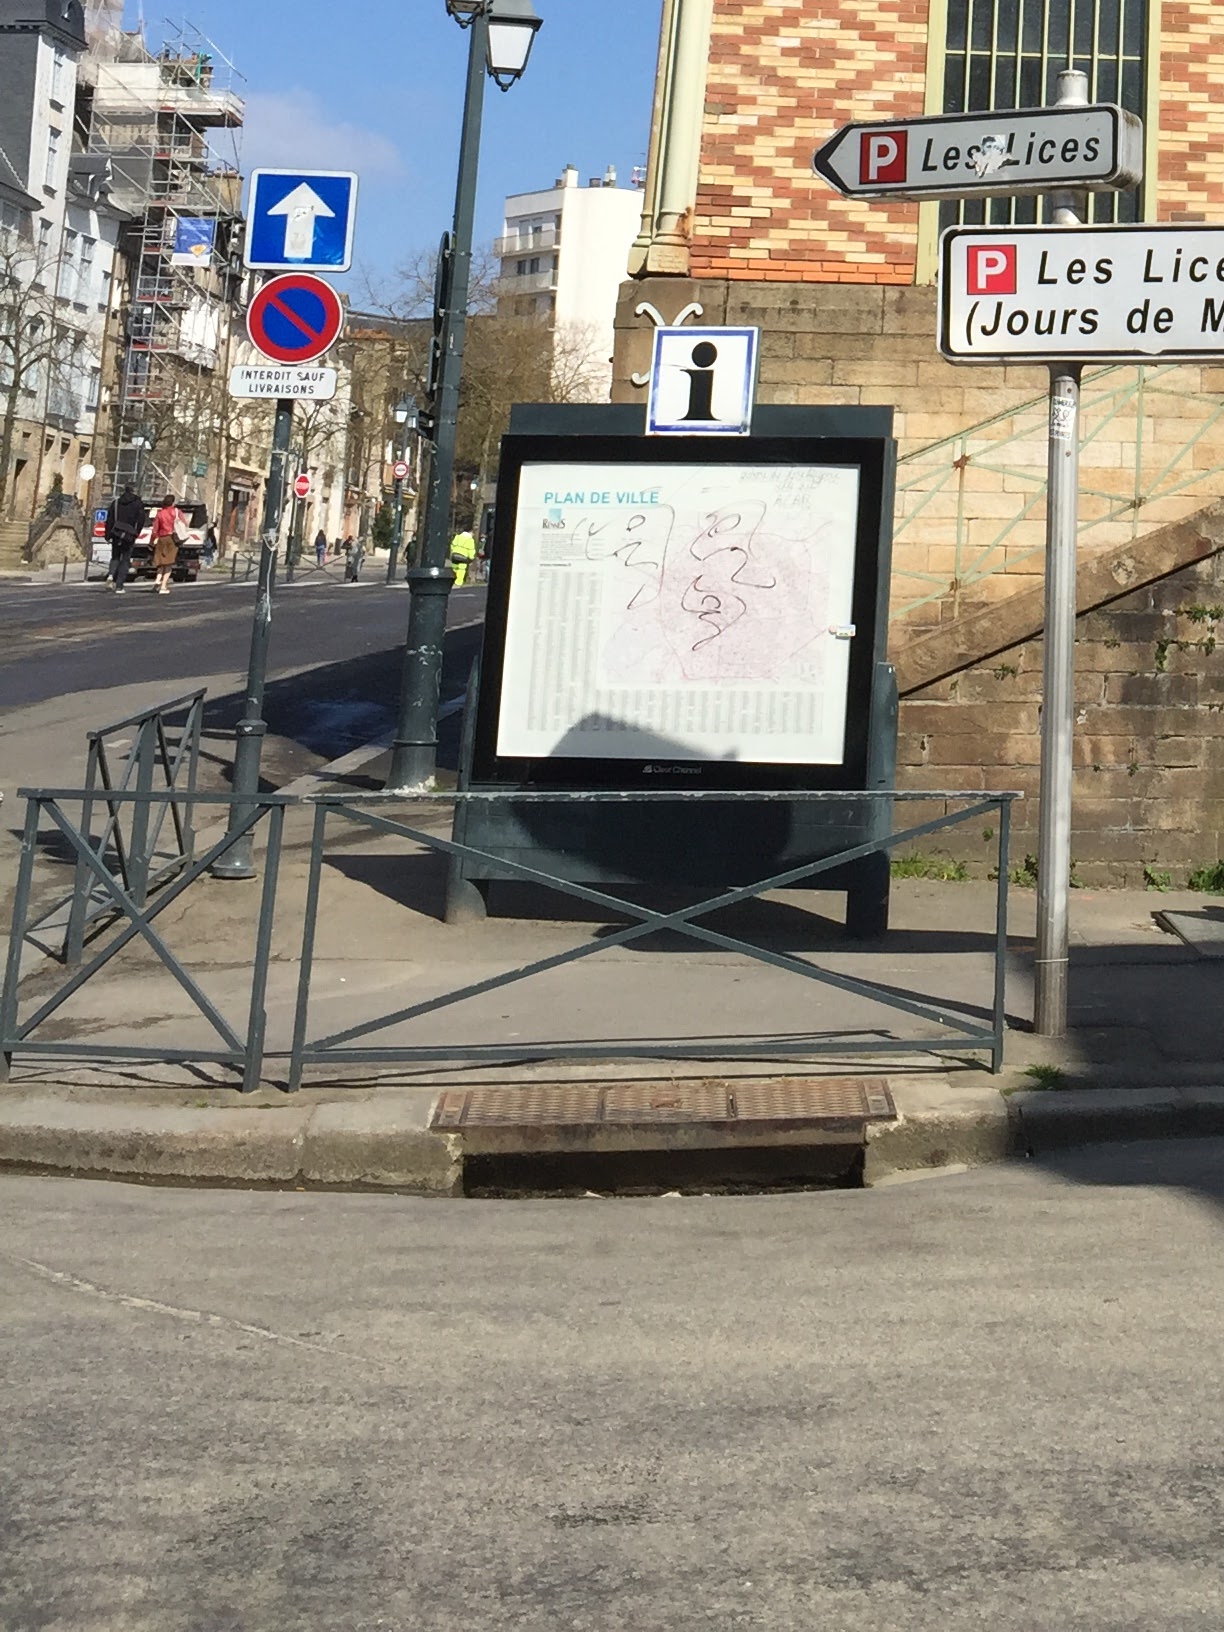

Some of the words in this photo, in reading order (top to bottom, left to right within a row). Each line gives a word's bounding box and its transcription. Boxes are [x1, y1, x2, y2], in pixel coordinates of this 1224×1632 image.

[868, 135, 898, 180] P
[921, 137, 982, 172] Les
[1003, 130, 1100, 167] Lices
[976, 250, 1007, 289] P
[1037, 250, 1114, 285] Les
[965, 301, 1099, 346] (Jours
[1126, 298, 1174, 334] de
[241, 370, 292, 380] INTERDIT
[297, 372, 325, 382] SAUF
[248, 384, 315, 394] LIVRAISONS
[544, 491, 585, 504] PLAN
[590, 491, 611, 504] DE
[616, 491, 660, 504] VILLE
